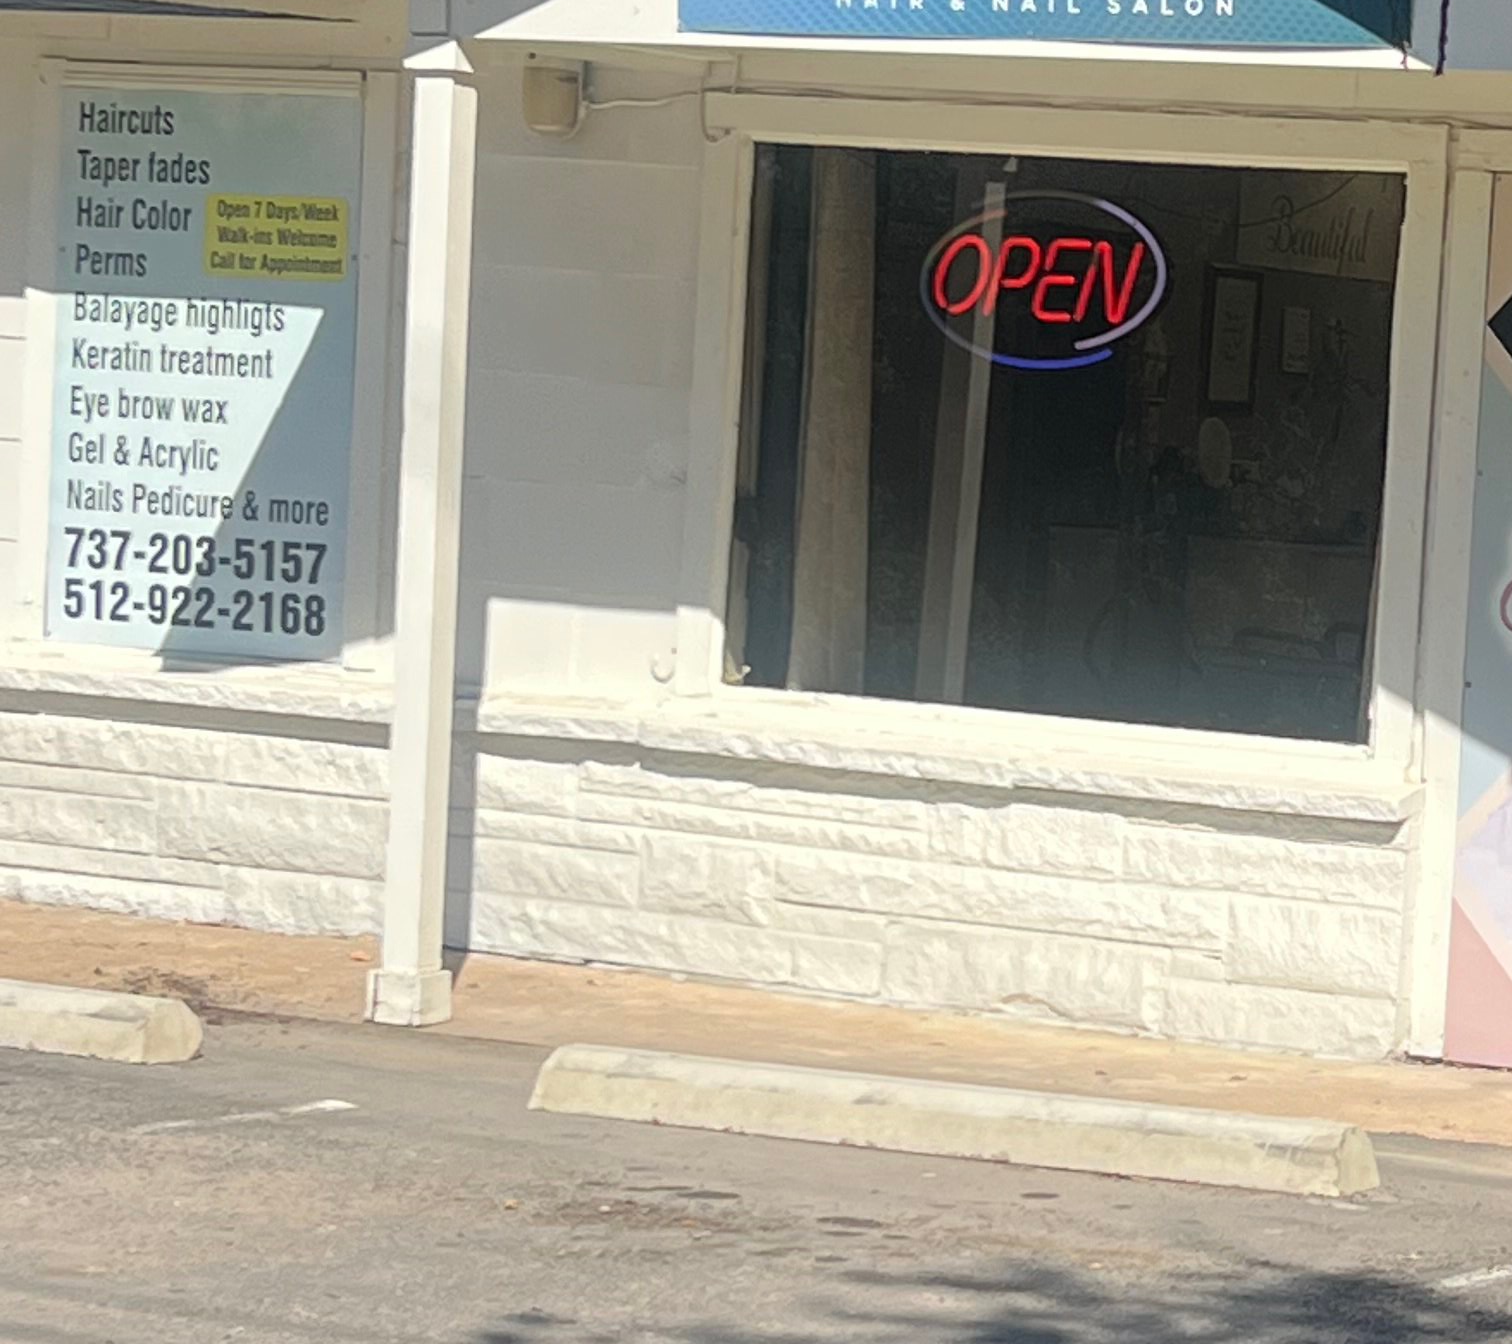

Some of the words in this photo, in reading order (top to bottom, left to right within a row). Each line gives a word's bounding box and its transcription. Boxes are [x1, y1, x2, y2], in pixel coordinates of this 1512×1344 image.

[78, 101, 175, 136] Haircuts
[77, 149, 141, 188] Taper
[148, 151, 211, 185] fades
[76, 196, 125, 229] Hair
[132, 198, 193, 232] Color
[217, 199, 250, 221] Open
[253, 200, 263, 219] 7
[277, 228, 337, 249] Welcome
[75, 243, 148, 278] Perms
[933, 233, 1145, 325] OPEN
[73, 291, 178, 332] Balayage
[185, 297, 286, 338] highligts
[71, 337, 152, 373] Keratin
[160, 343, 274, 379] treatment
[70, 385, 110, 423] Eye
[118, 387, 175, 421] brow
[182, 397, 230, 425] wax
[68, 431, 105, 465] Gel
[113, 434, 131, 466] &
[138, 436, 220, 476] Acrylic
[67, 478, 124, 514] Nails
[132, 482, 234, 520] Pedicure
[241, 490, 259, 522] &
[268, 498, 330, 526] more
[63, 526, 328, 585] 737-203-5157
[63, 577, 326, 637] 512-922-2168
